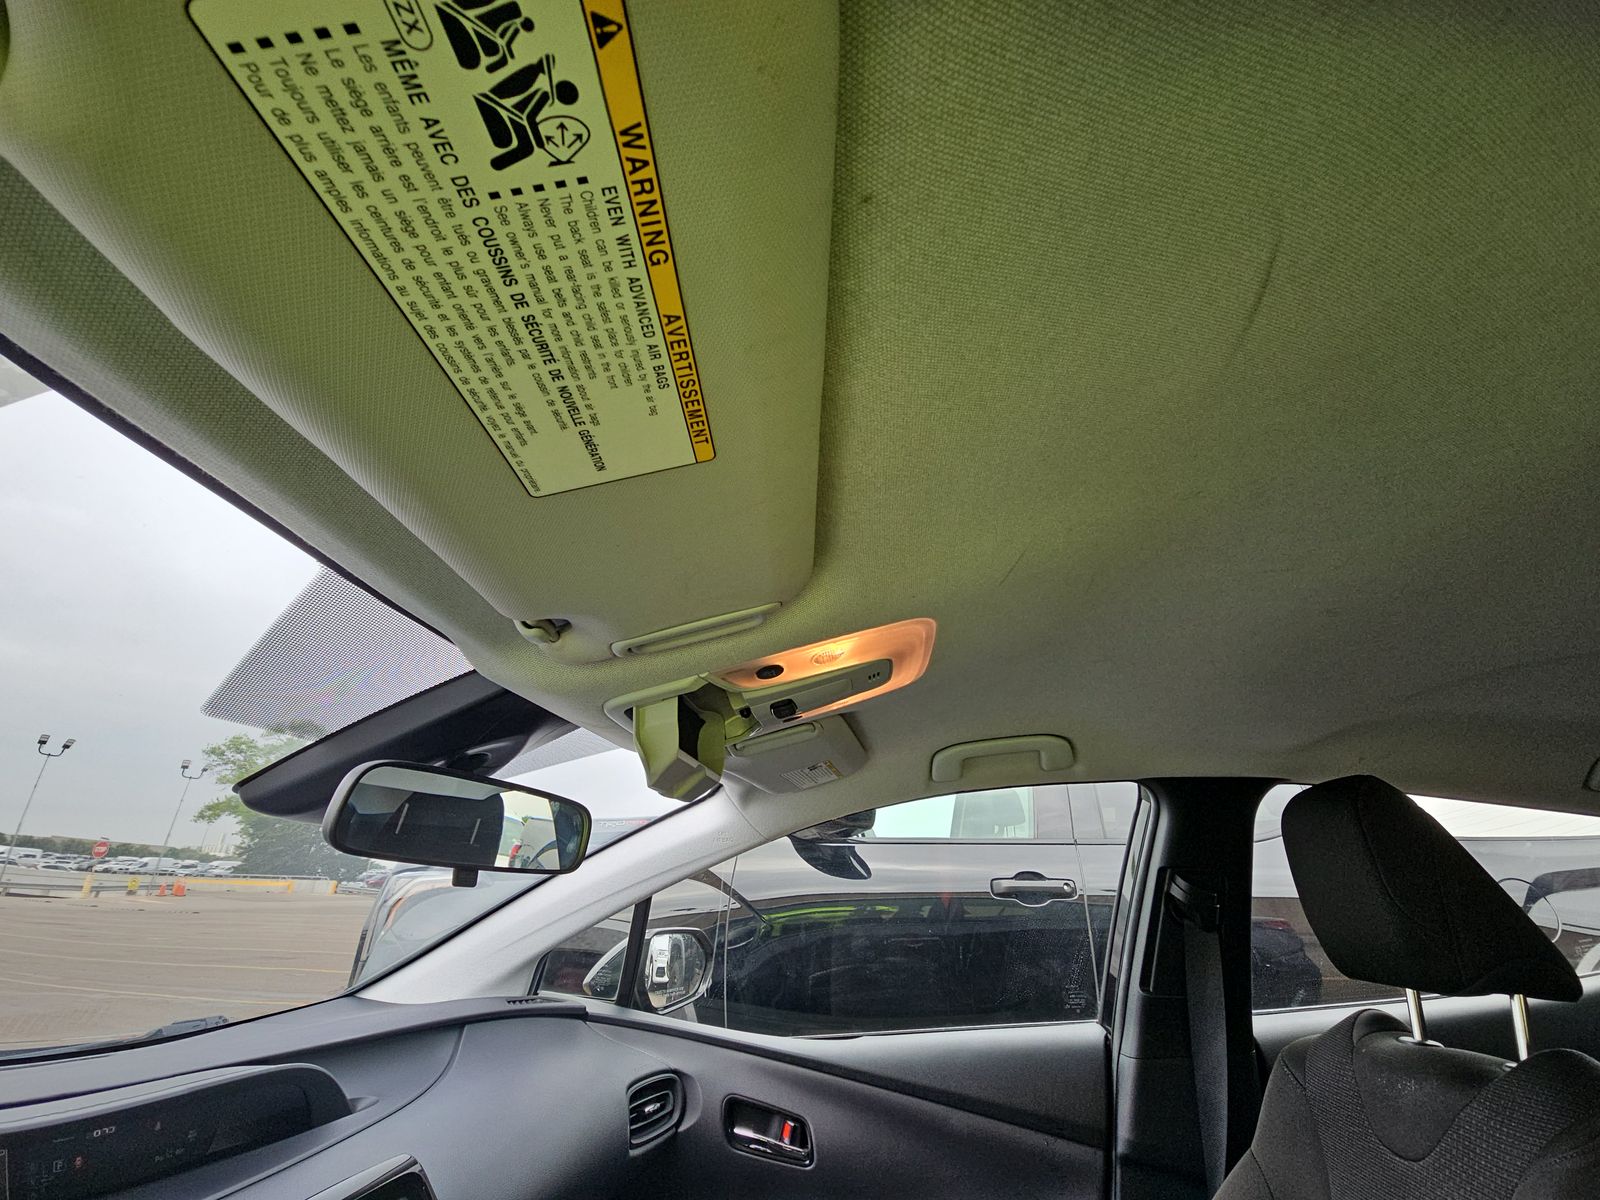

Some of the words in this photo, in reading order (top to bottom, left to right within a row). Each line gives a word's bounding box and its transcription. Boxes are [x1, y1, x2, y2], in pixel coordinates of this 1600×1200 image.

[323, 47, 346, 69] Le
[352, 42, 378, 74] Les
[381, 40, 430, 106] MÊME
[340, 76, 374, 118] siège
[374, 81, 411, 135] enfants
[369, 124, 403, 168] arrière
[418, 116, 460, 166] AVEC
[402, 141, 444, 192] peuvent
[398, 173, 420, 193] est
[448, 174, 481, 209] DES
[269, 55, 321, 125] Toujours
[316, 131, 355, 174] utiliser
[349, 179, 370, 200] les
[365, 204, 405, 254] ceintures
[401, 257, 416, 272] de
[412, 274, 444, 310] sécurité
[437, 312, 451, 323] et
[445, 324, 459, 338] les
[454, 339, 483, 374] systèmes
[295, 51, 320, 77] Ne
[315, 83, 356, 135] mettez
[345, 139, 386, 183] jamais
[381, 188, 399, 205] un
[394, 209, 420, 239] siège
[412, 243, 438, 267] pour
[433, 271, 459, 300] enfant
[452, 302, 479, 331] orienté
[472, 333, 487, 351] vers
[482, 351, 504, 379] l'arrière
[437, 196, 456, 219] être
[537, 197, 557, 228] Never
[559, 192, 574, 215] The
[580, 189, 602, 235] Children
[600, 184, 627, 227] EVEN
[238, 61, 275, 99] Pour
[270, 106, 292, 127] de
[285, 133, 318, 164] plus
[314, 169, 353, 214] amples
[348, 217, 400, 281] informations
[395, 284, 411, 297] au
[406, 300, 430, 322] sujet
[423, 324, 440, 340] des
[435, 342, 463, 374] coussins
[412, 197, 448, 243] l'endroit
[452, 223, 472, 247] tués
[547, 233, 567, 251] put
[568, 219, 586, 245] back
[441, 245, 454, 257] le
[466, 250, 481, 264] ou
[471, 215, 519, 288] COUSSINS
[558, 254, 569, 262] a
[577, 248, 594, 269] seat
[595, 238, 609, 257] can
[614, 232, 638, 270] WITH
[445, 260, 468, 281] plus
[493, 204, 511, 227] See
[505, 231, 532, 270] owner's
[525, 272, 549, 305] manual
[541, 307, 554, 319] for
[548, 322, 563, 343] more
[586, 271, 597, 281] is
[602, 259, 614, 273] be
[463, 284, 479, 299] sûr
[472, 267, 509, 314] gravement
[515, 201, 539, 239] Always
[532, 242, 548, 261] use
[542, 264, 559, 285] seat
[552, 286, 568, 309] belts
[562, 311, 578, 327] and
[570, 329, 586, 347] child
[578, 349, 597, 380] restraints
[563, 265, 588, 311] rear-facing
[590, 283, 603, 298] the
[607, 275, 624, 299] killed
[618, 121, 669, 267] WARNING
[662, 313, 709, 444] AVERTISSEMENT
[470, 302, 492, 322] pour
[508, 291, 531, 310] DE
[596, 300, 613, 325] safest
[615, 301, 626, 311] or
[625, 276, 656, 339] ADVANCED
[486, 324, 500, 338] les
[502, 316, 525, 346] blessés
[582, 312, 598, 332] child
[619, 313, 638, 346] seriously
[520, 313, 557, 366] SÉCURITÉ
[590, 334, 605, 351] seat
[603, 327, 620, 348] place
[516, 348, 532, 361] par
[597, 351, 608, 360] in
[614, 349, 625, 359] for
[630, 348, 647, 373] injured
[645, 343, 662, 361] AIR
[527, 362, 537, 371] le
[547, 368, 565, 383] DE
[601, 361, 612, 373] the
[651, 364, 671, 390] BAGS
[555, 384, 587, 428] NOUVELLE
[577, 428, 607, 472] GÉNÉRATION
